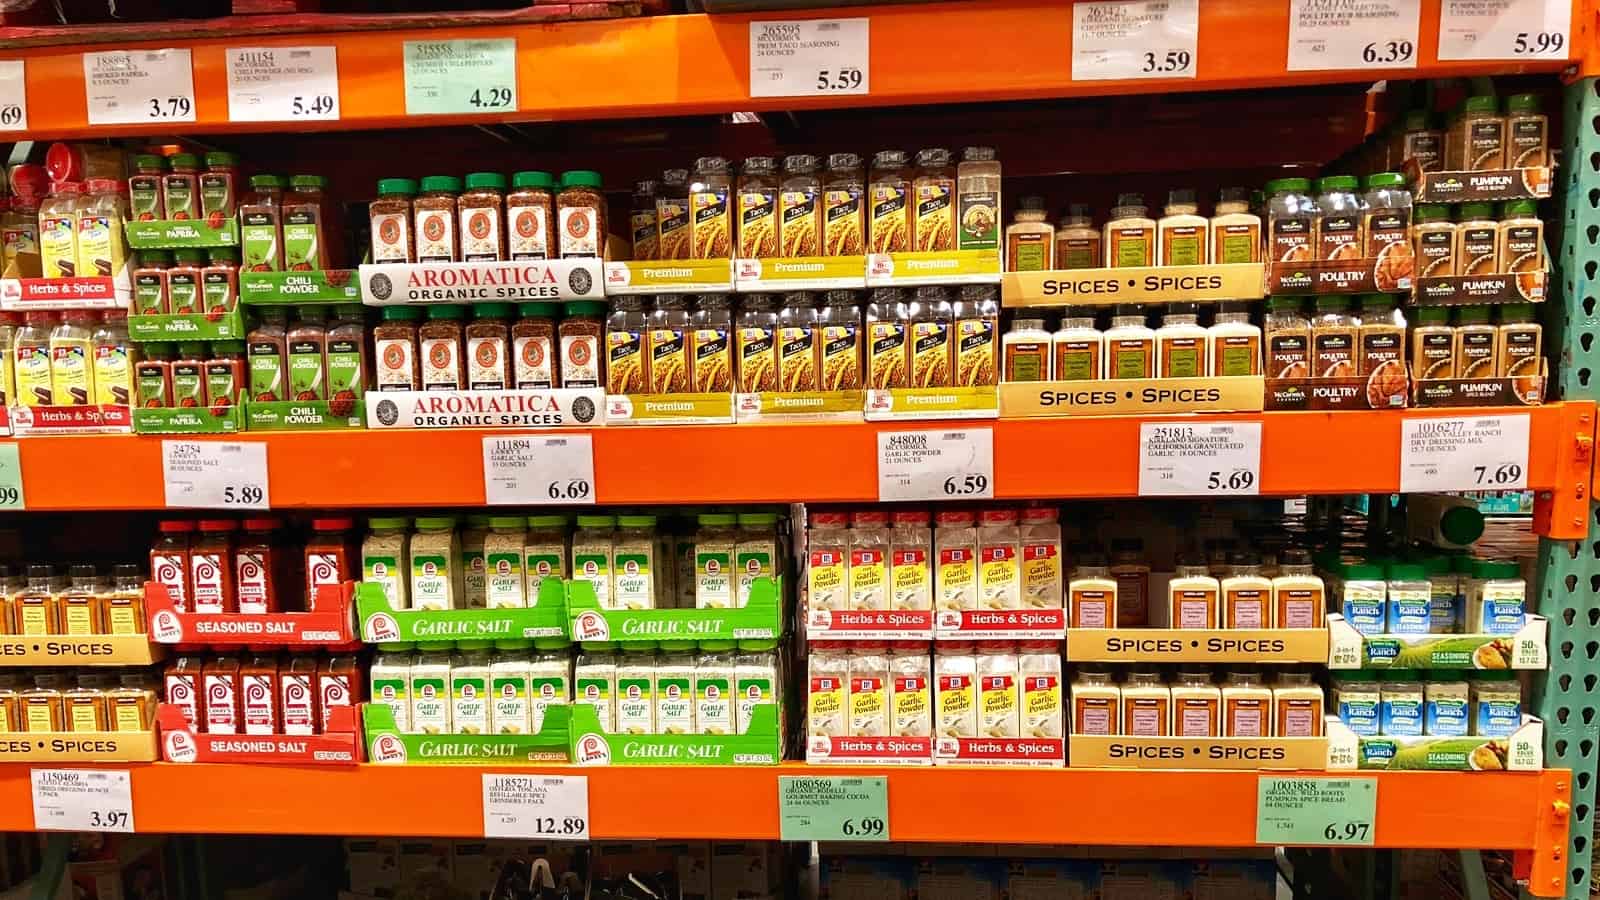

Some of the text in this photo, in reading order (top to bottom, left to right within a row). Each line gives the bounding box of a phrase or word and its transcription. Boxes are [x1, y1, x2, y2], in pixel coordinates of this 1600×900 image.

[762, 24, 801, 36] 265595
[1513, 32, 1564, 53] 5.99
[239, 51, 274, 62] 411154
[1362, 41, 1413, 63] 6.39
[1143, 51, 1191, 73] 3.59
[817, 69, 862, 90] 5.59
[469, 88, 512, 107] 4.29
[149, 97, 190, 117] 3.79
[292, 95, 333, 115] 5.49
[1470, 176, 1512, 186] PUMPKIN
[165, 230, 201, 239] PAPRIKA
[1373, 233, 1403, 241] POULTRY
[774, 262, 825, 272] Premium
[907, 259, 960, 270] Premium
[407, 267, 557, 287] AROMATICA
[642, 268, 694, 279] Premium
[1319, 271, 1366, 281] POULTRY
[285, 276, 311, 286] CHILI
[1043, 275, 1222, 295] SPICES SPICES
[1462, 280, 1505, 290] PUMPKIN
[29, 284, 106, 296] Herbs & Spices
[279, 284, 319, 295] POWDER
[408, 286, 560, 300] ORGANIC SPICES
[165, 322, 199, 332] PAPRIKA
[1313, 387, 1359, 398] POULTRY
[1460, 383, 1503, 392] PUMPKIN
[773, 397, 824, 407] Premium
[906, 395, 957, 405] Premium
[1039, 388, 1220, 406] SPICES SPICES
[413, 395, 561, 414] AROMATICA
[645, 402, 695, 412] Premium
[41, 411, 82, 422] Herbs &
[290, 407, 316, 416] CHILI
[169, 415, 202, 425] PAPRIKA
[284, 414, 323, 425] POWDER
[413, 414, 563, 426] ORGANIC SPICES
[1153, 427, 1193, 438] 251813
[1418, 421, 1464, 433] 1016277
[1475, 429, 1502, 437] RANCH
[496, 439, 530, 450] 111894
[890, 434, 927, 445] 848008
[1193, 442, 1244, 450] GRANULATED
[1474, 464, 1521, 484] 7.69
[943, 475, 988, 495] 6.59
[1207, 471, 1254, 490] 5.69
[224, 486, 263, 504] 5.89
[548, 480, 589, 499] 6.69
[840, 615, 925, 627] Herbs & Spices
[970, 614, 1057, 626] Herbs & Spices
[196, 622, 296, 633] SEASONED SALT
[412, 620, 474, 636] GARLIC
[476, 619, 514, 635] SALT
[622, 619, 684, 635] GARLIC
[684, 619, 725, 634] SALT
[47, 643, 113, 655] SPICES
[1106, 637, 1285, 652] SPICES SPICES
[1370, 648, 1397, 657] Ranch
[51, 740, 117, 752] SPICES
[210, 741, 308, 753] SEASONED SALT
[419, 742, 519, 758] GARLIC SALT
[623, 742, 685, 758] GARLIC
[685, 744, 725, 759] SALT
[840, 741, 924, 753] Herbs & Spices
[968, 743, 1055, 755] Herbs & Spices
[1109, 743, 1286, 760] SPICES SPICES
[1366, 748, 1393, 758] Ranch
[42, 772, 79, 782] 1150469
[494, 778, 533, 788] 1185271
[791, 779, 832, 790] 1080569
[1272, 781, 1317, 792] 1003858
[90, 810, 129, 828] 3.97
[535, 817, 585, 834] 12.89
[842, 818, 884, 836] 6.99
[1324, 822, 1370, 841] 6.97
